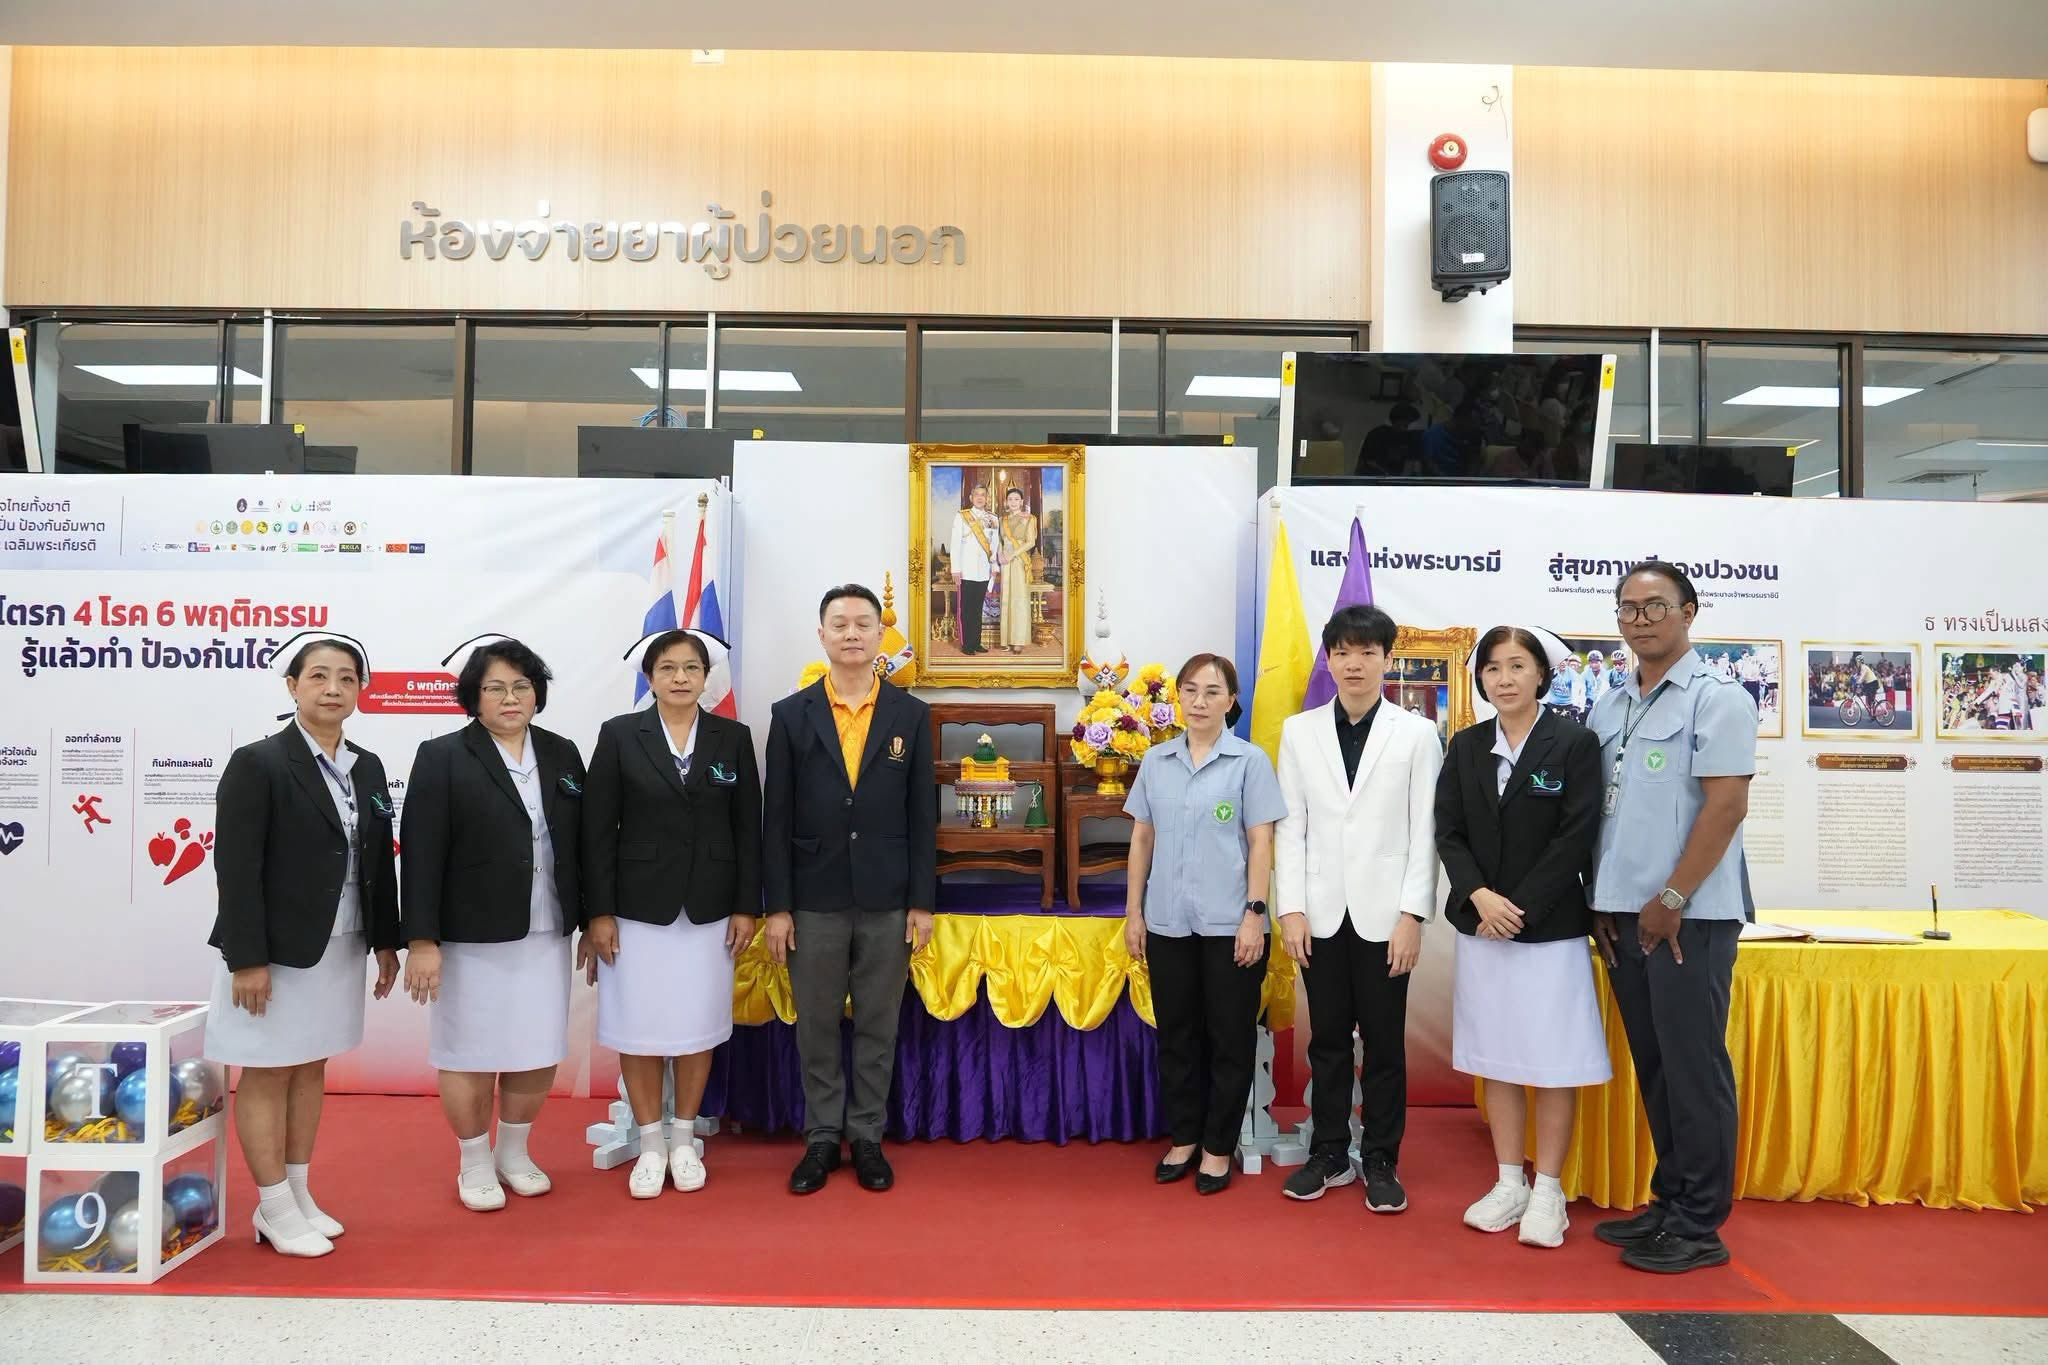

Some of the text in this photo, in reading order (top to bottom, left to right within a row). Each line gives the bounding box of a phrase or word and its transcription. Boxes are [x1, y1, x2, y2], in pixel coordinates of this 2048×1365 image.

[399, 191, 966, 280] ห้องจ่ายยาผู้ป่วยนอก
[19, 518, 105, 532] ป้องกันอัมพาต
[4, 538, 97, 551] เฉลิมพระเกียรติ
[1310, 546, 1502, 572] แสห่งพระบารมี
[73, 601, 92, 626] 4
[98, 596, 148, 626] โรค
[156, 600, 176, 627] 6
[184, 599, 329, 632] พฤติกรรม
[21, 636, 279, 677] รู้แล้วทำ ป้องกันได้
[406, 680, 459, 693] 6 พฤติกร
[65, 733, 122, 743] ออกกำลังกาย
[0, 746, 37, 756] หัวใจเต้น
[152, 758, 213, 768] กินผักและผลไม้
[388, 779, 404, 788] หล้า
[75, 1063, 118, 1118] T
[72, 1191, 107, 1250] 9
